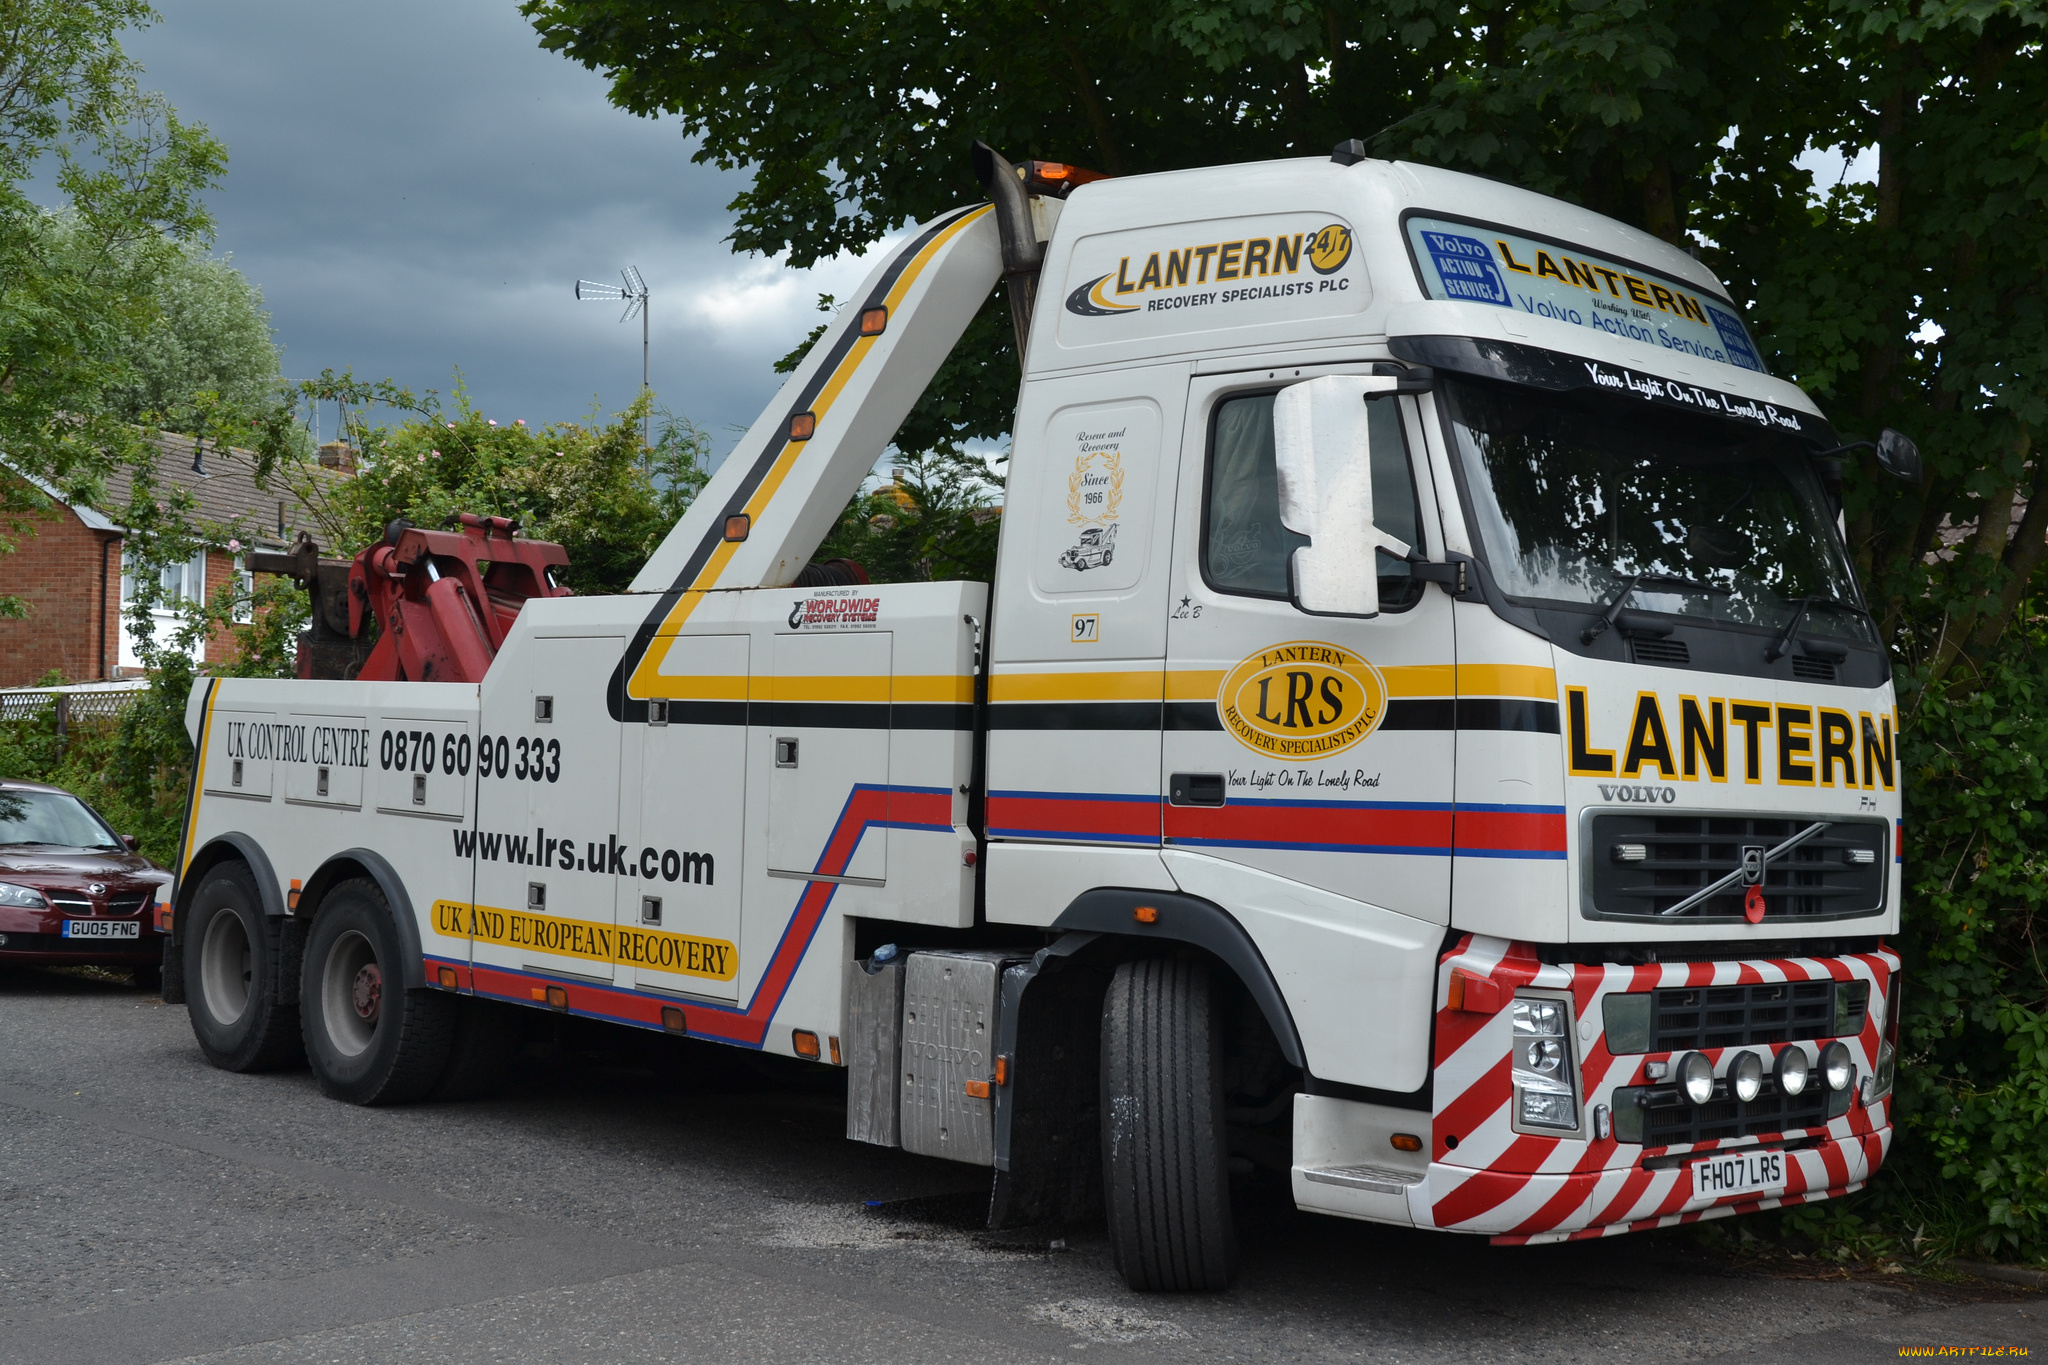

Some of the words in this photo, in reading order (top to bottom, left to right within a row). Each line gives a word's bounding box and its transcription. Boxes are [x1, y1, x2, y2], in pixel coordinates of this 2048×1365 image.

[1429, 234, 1486, 257] Volvo
[1115, 232, 1304, 296] LANTERN
[1439, 257, 1484, 279] ACTION
[1444, 278, 1496, 301] SERVICE
[1495, 239, 1710, 327] LANTERN
[1147, 291, 1218, 312] RECOVERY
[1222, 281, 1314, 303] SPECIALISTS
[1319, 278, 1350, 293] PLC
[1592, 298, 1628, 318] Working
[1631, 308, 1651, 321] With
[1517, 294, 1582, 325] Volvo
[1592, 311, 1655, 344] Action
[1658, 328, 1726, 363] Service
[1584, 362, 1624, 389] Your
[1624, 371, 1664, 400] Light
[1667, 381, 1694, 405] On
[1689, 388, 1721, 410] The
[1720, 394, 1767, 426] Lonely
[1765, 405, 1802, 431] Road
[1076, 431, 1106, 441] Rescue
[1108, 427, 1126, 439] and
[1079, 442, 1119, 452] Recovery
[1081, 472, 1109, 487] Since
[1084, 492, 1103, 505] 1966
[806, 598, 880, 613] WORLDWIDE
[1171, 606, 1190, 619] Lee
[1193, 605, 1202, 619] B
[803, 613, 841, 623] RECOVERY
[842, 612, 877, 622] SYSTEMS
[1075, 619, 1095, 637] 97
[1262, 647, 1345, 668] LANTERN
[1256, 671, 1343, 728] LRS
[1225, 705, 1278, 751] RECOVERY
[1280, 727, 1355, 754] SPECIALISTS
[1356, 707, 1377, 735] PLC
[1564, 685, 1896, 792] LANTERN
[228, 722, 245, 758] UK
[249, 723, 308, 763] CONTROL
[312, 726, 370, 767] CENTRE
[380, 730, 435, 773] 0870
[442, 733, 471, 776] 60
[479, 735, 509, 779] 90
[515, 736, 561, 783] 333
[1228, 768, 1247, 786] Your
[1250, 769, 1276, 791] Light
[1278, 769, 1294, 787] On
[1297, 769, 1313, 787] The
[1318, 769, 1350, 791] Lonely
[1353, 769, 1381, 788] Road
[1598, 784, 1676, 803] VOLVO
[1859, 796, 1877, 811] FH
[453, 828, 714, 885] www.lrs.uk.com
[72, 922, 108, 936] GU05
[112, 923, 137, 936] FNC
[439, 905, 463, 932] UK
[468, 908, 504, 939] AND
[510, 916, 611, 957] EUROPEAN
[618, 931, 729, 975] RECOVERY
[907, 1040, 983, 1067] VOLVO
[1700, 1161, 1745, 1192] FH07
[1750, 1155, 1781, 1185] LRS
